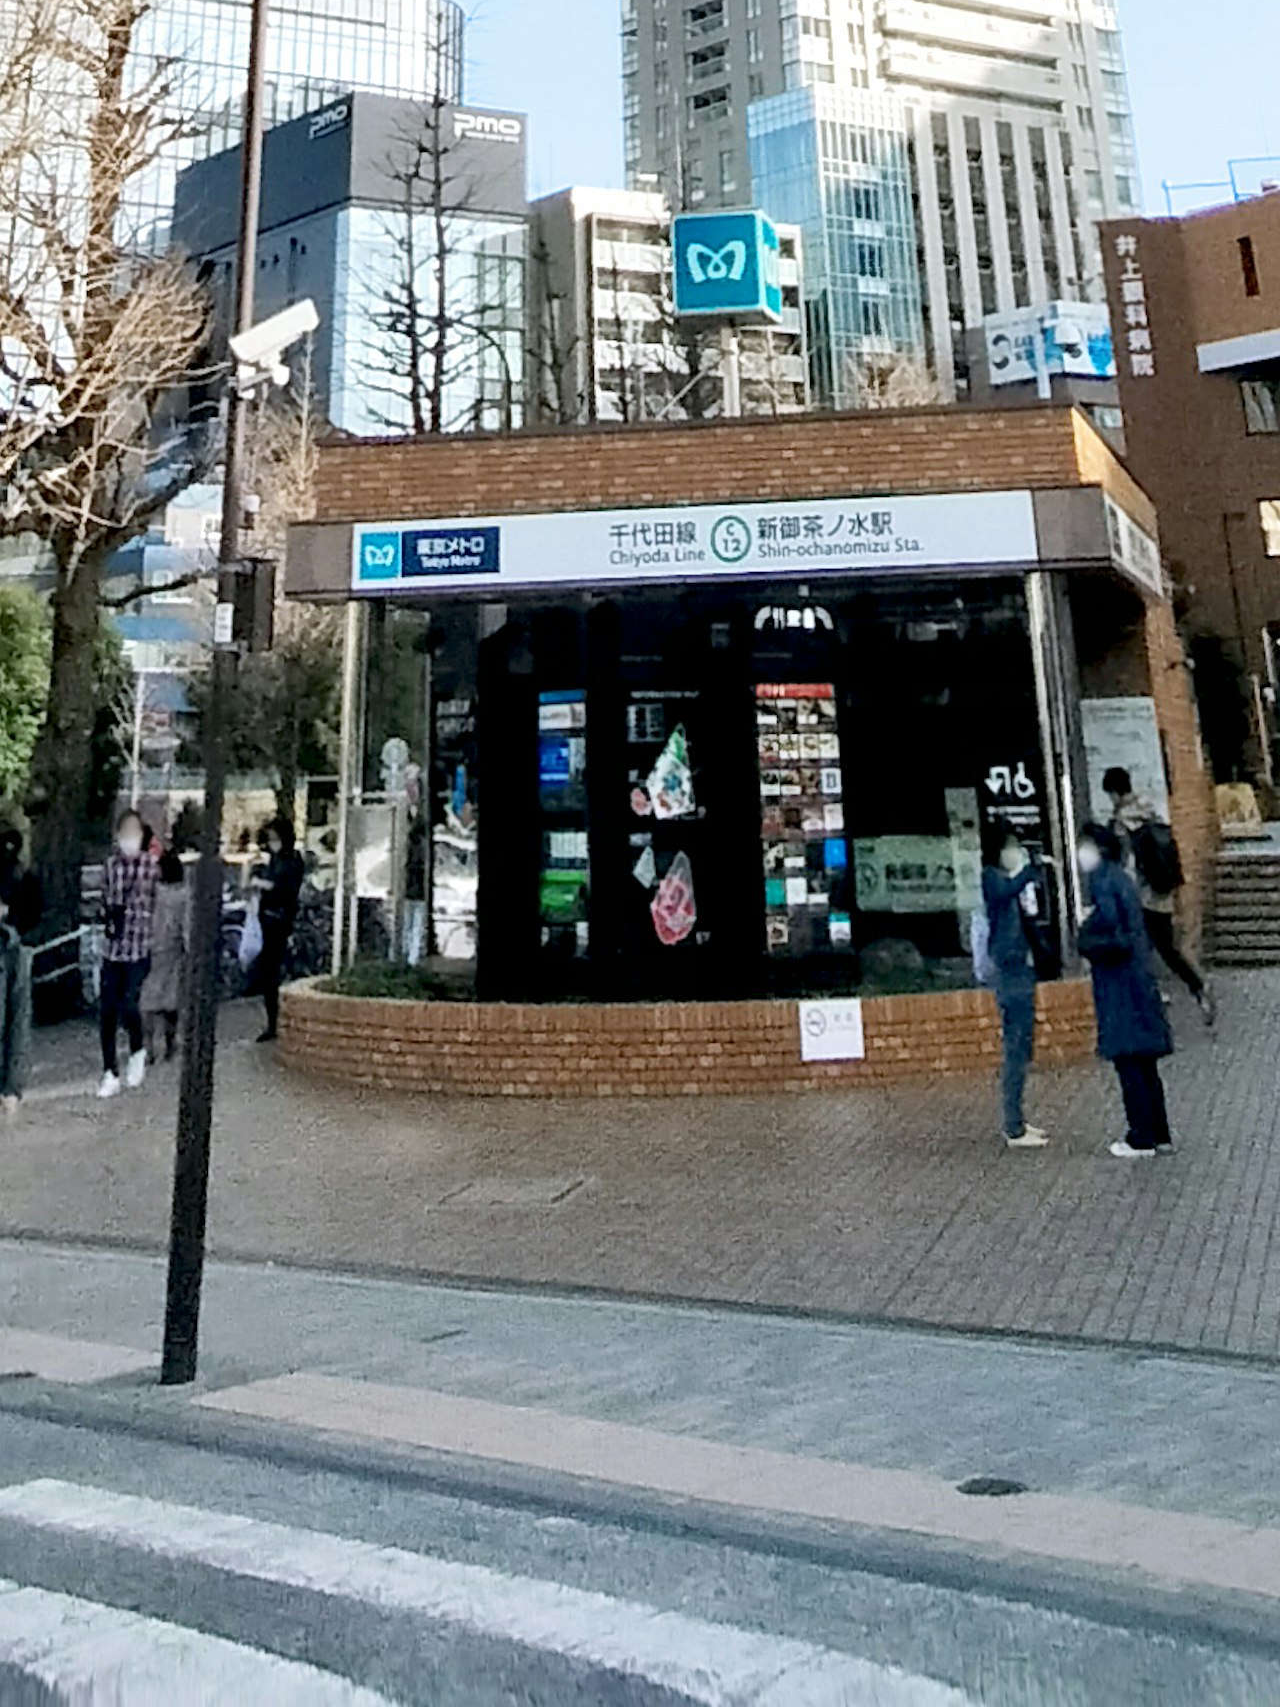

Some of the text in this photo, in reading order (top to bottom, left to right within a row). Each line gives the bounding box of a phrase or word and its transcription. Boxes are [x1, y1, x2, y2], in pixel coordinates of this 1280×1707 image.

[609, 521, 698, 547] 千代田線
[725, 524, 736, 537] C
[756, 511, 894, 541] 新御茶ノ水駅
[721, 538, 742, 553] 12
[757, 536, 925, 559] Shin-ochanomizu Sta.
[609, 547, 706, 568] Chiyoda Line
